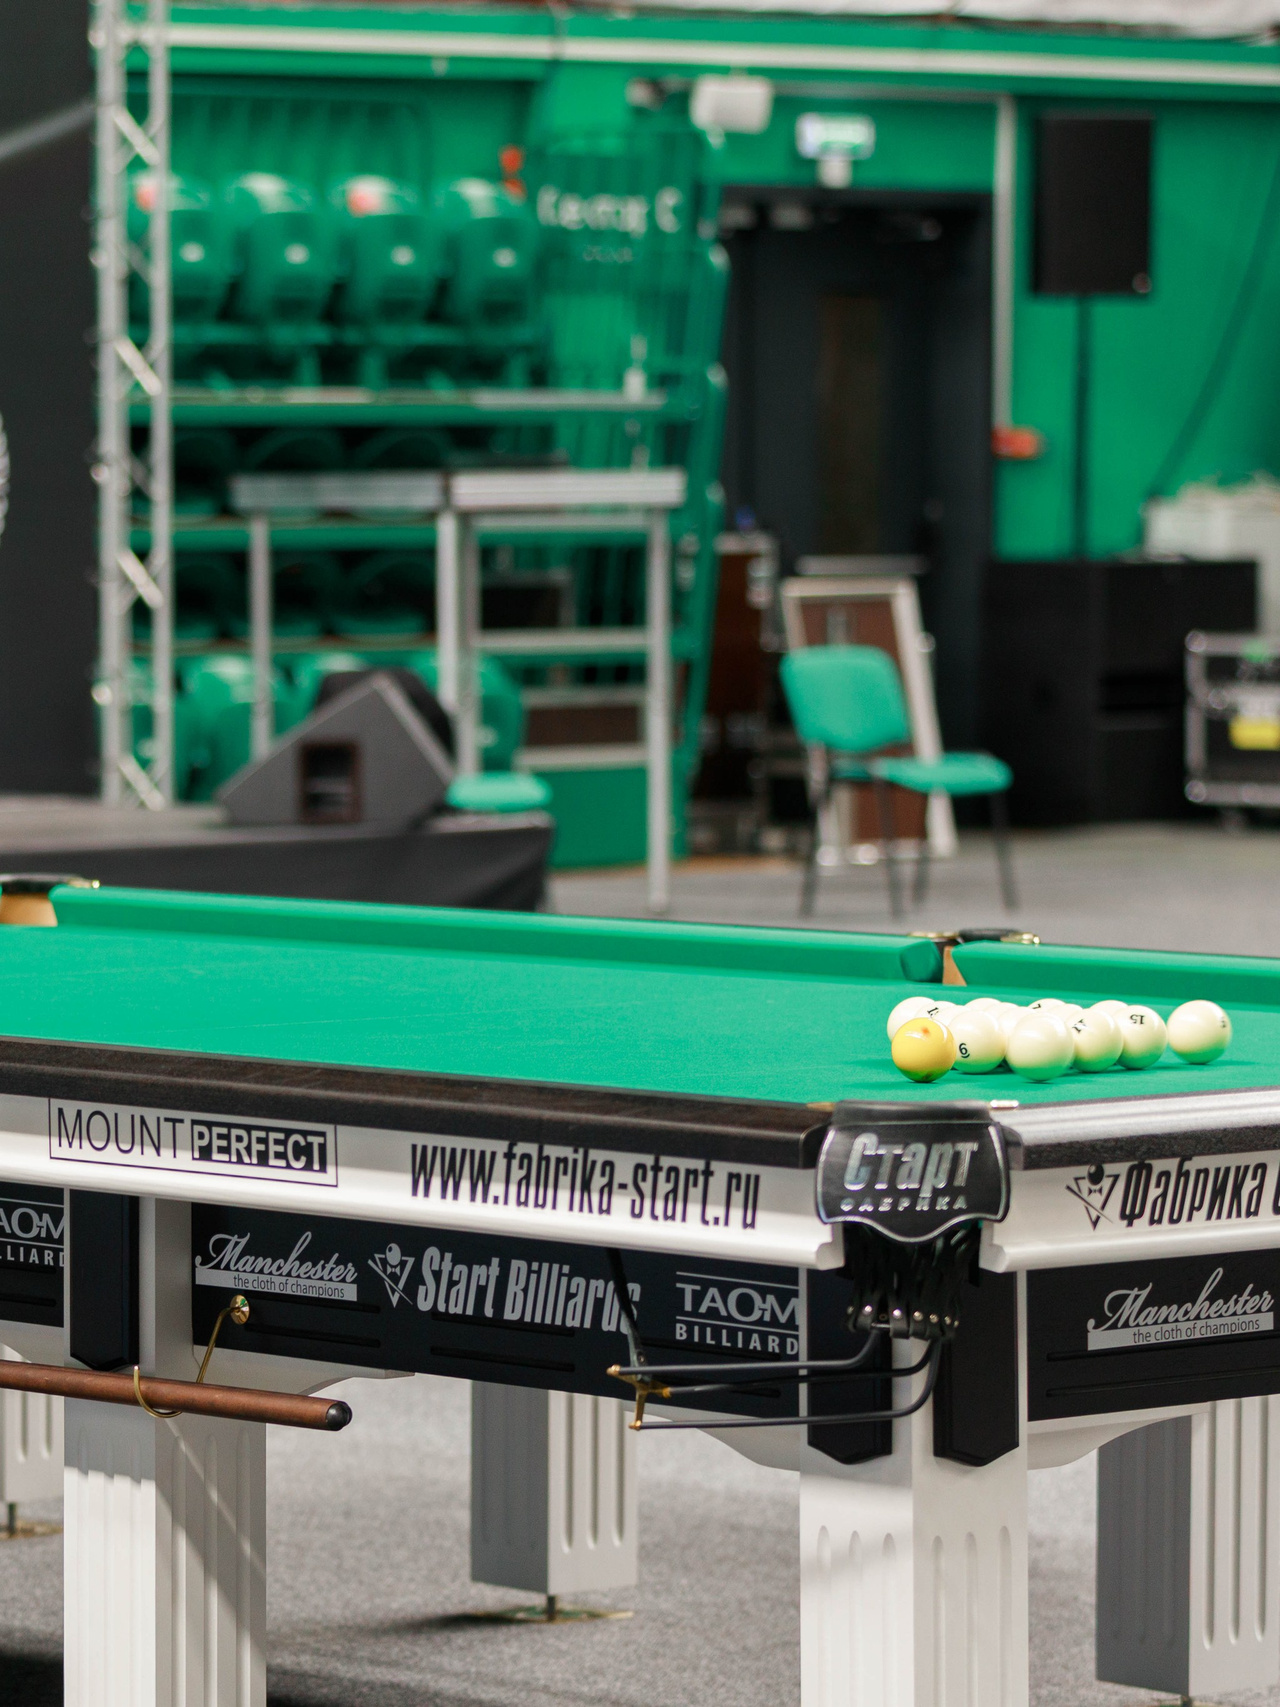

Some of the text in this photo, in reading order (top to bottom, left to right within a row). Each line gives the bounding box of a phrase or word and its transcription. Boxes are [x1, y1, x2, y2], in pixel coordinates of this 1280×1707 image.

[959, 1043, 970, 1058] 6
[58, 1109, 326, 1172] MOUNT PERFECT
[844, 1133, 978, 1197] Старт
[410, 1141, 760, 1229] www.fabrika-start.ru
[840, 1195, 968, 1212] ФАБРИКА
[1120, 1157, 1267, 1228] Фабрика
[195, 1231, 358, 1283] Manchester
[417, 1246, 500, 1318] Start
[233, 1274, 345, 1299] the cloth of champions
[676, 1283, 799, 1326] TAOM
[1087, 1267, 1274, 1333] Manchester
[1133, 1317, 1260, 1344] the cloth of champions
